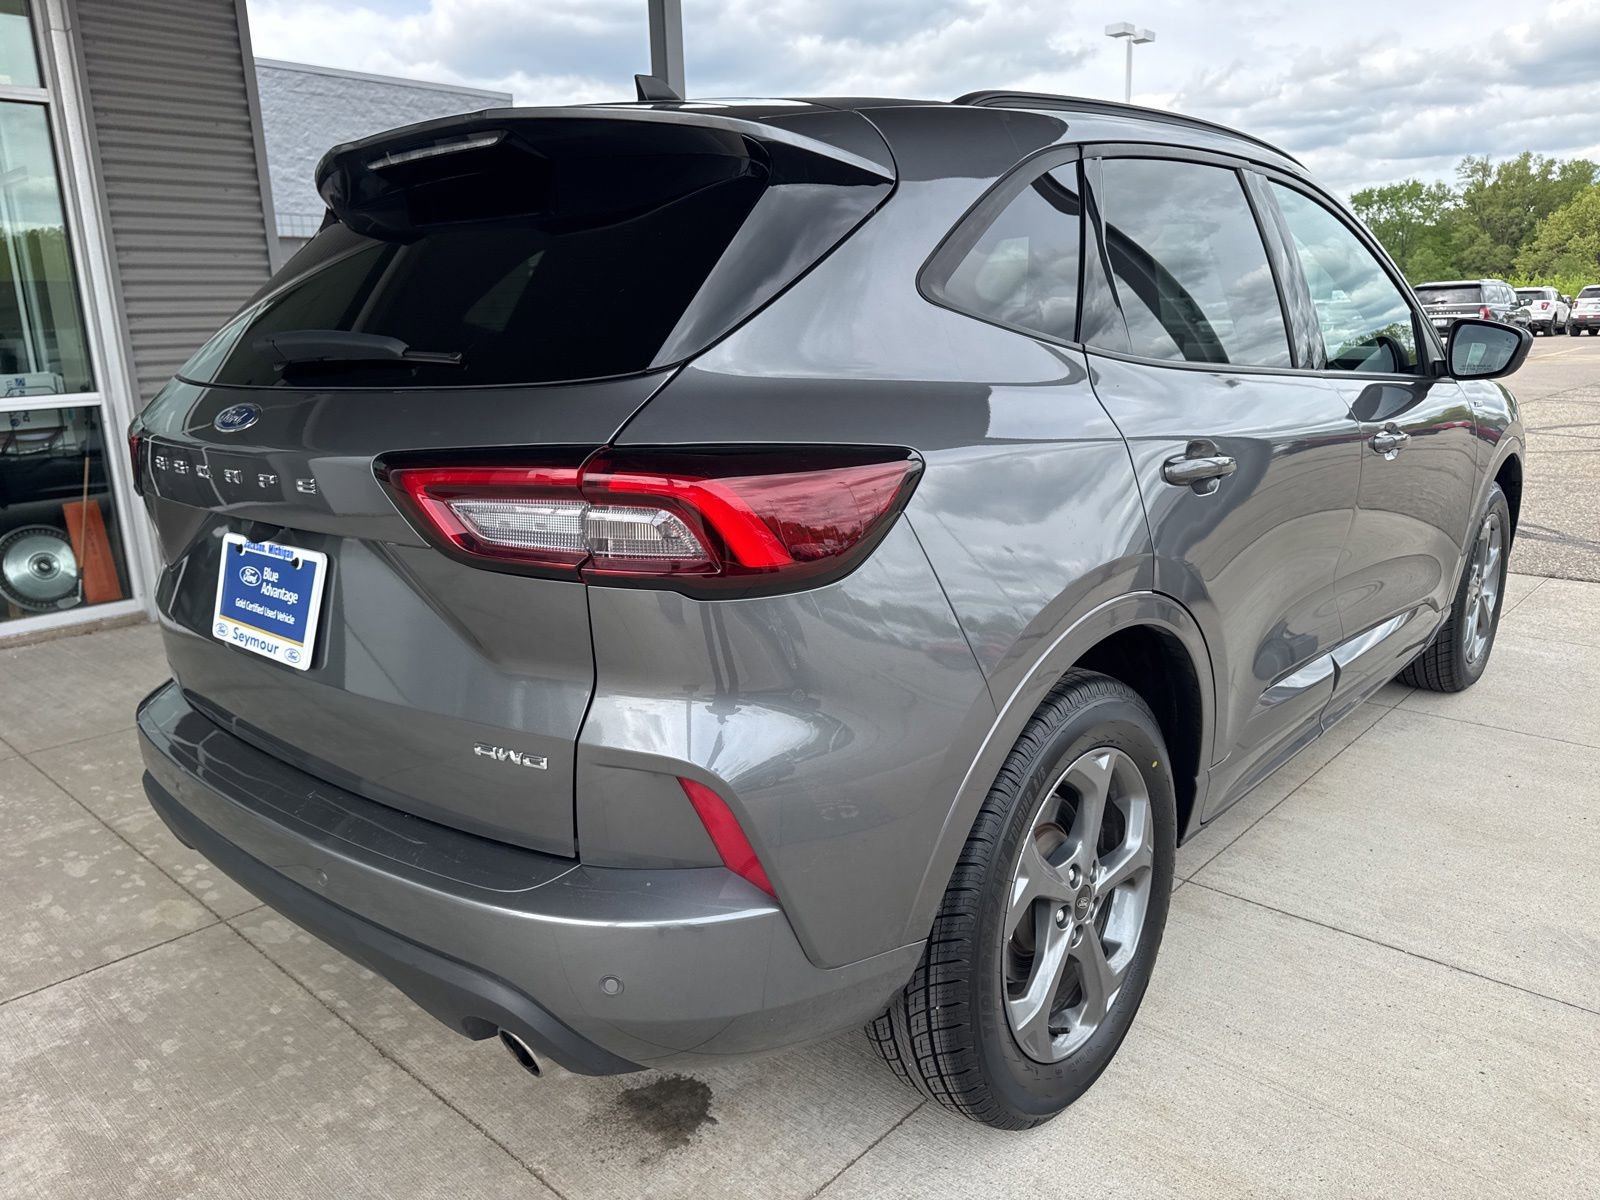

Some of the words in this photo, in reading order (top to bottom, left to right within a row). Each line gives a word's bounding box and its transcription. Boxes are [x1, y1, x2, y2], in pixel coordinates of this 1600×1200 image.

[220, 404, 256, 428] Ford
[155, 455, 317, 494] ESCAPE
[268, 544, 294, 560] Michigan
[241, 567, 260, 584] Ford
[263, 566, 279, 582] Blue
[260, 581, 299, 605] Advantage
[235, 597, 247, 609] Gold
[246, 602, 265, 615] Certified
[264, 606, 277, 618] Used
[277, 610, 296, 625] Vehicle
[232, 626, 280, 655] Seymour
[473, 743, 548, 770] AWD
[1007, 788, 1033, 845] TOURING
